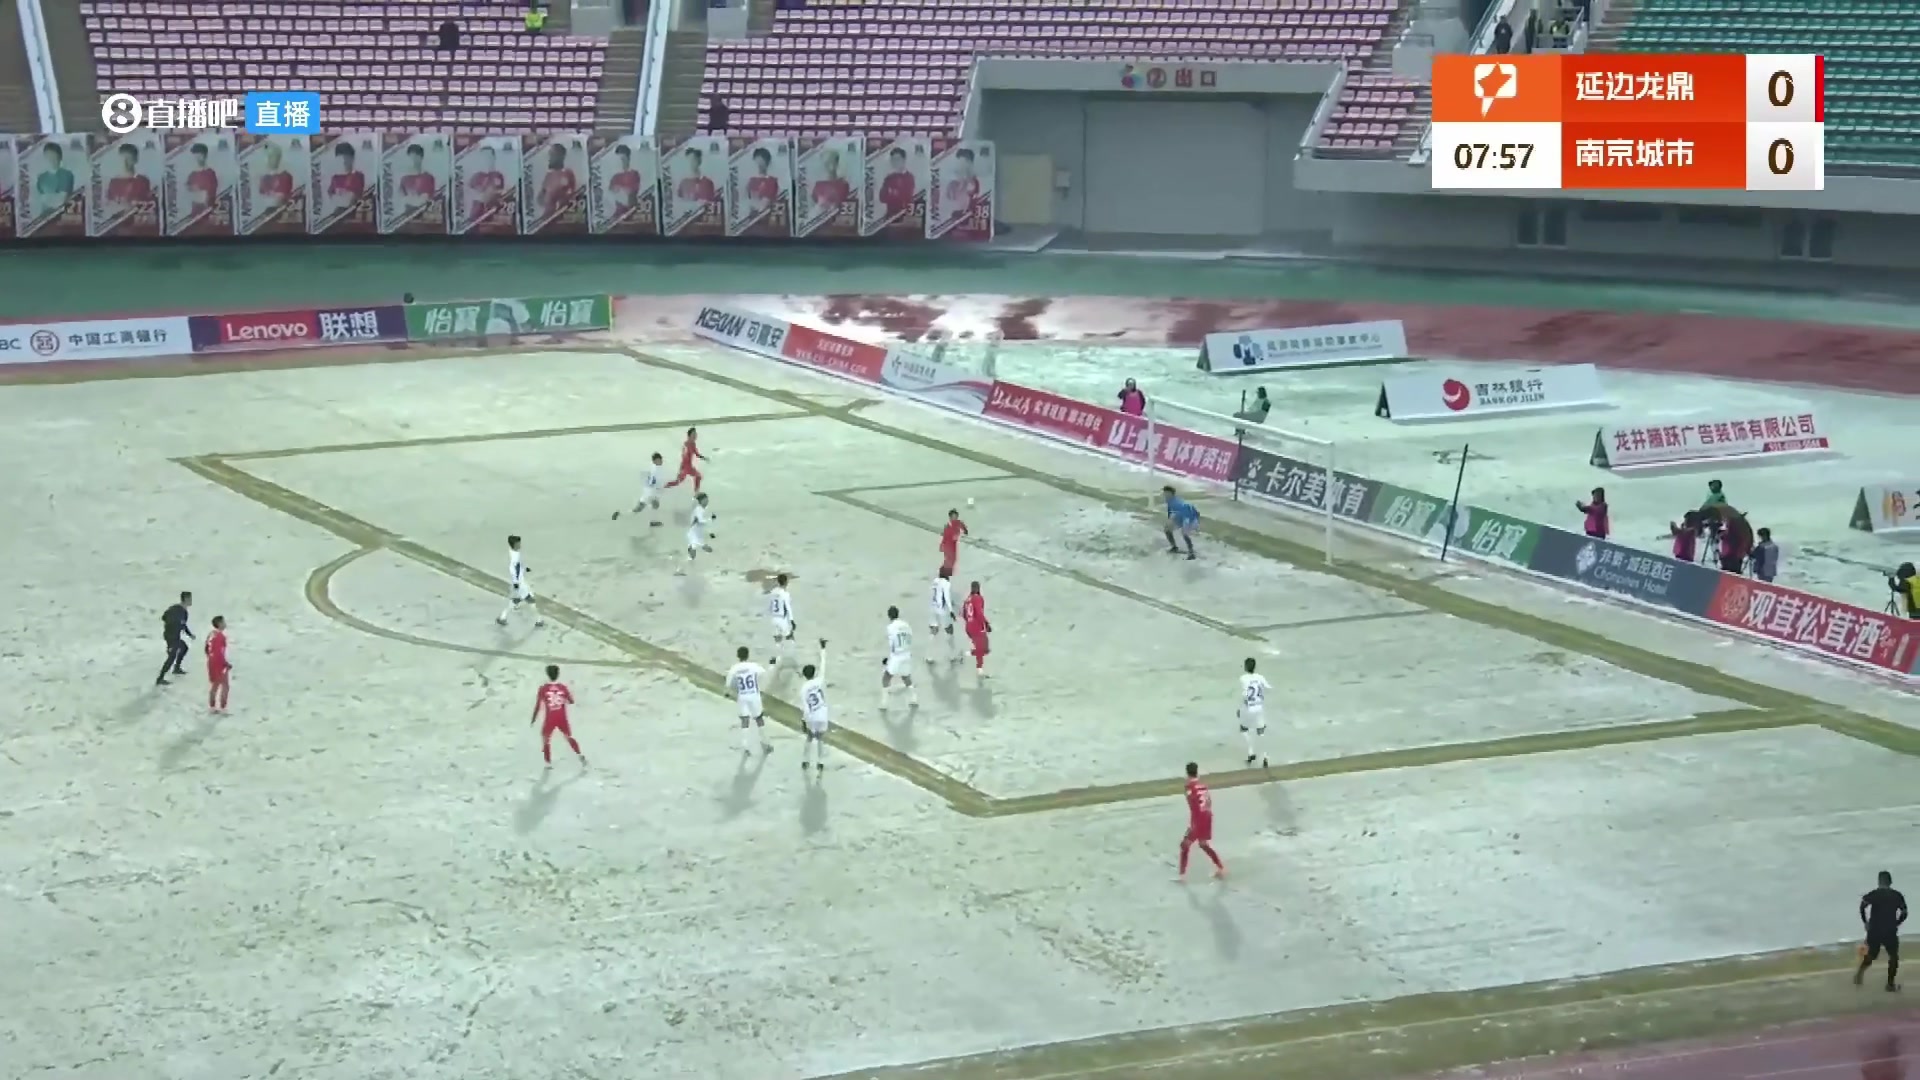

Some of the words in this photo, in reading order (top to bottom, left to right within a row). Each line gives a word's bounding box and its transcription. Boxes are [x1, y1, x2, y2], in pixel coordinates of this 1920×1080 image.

[226, 322, 308, 341] Lenovo
[319, 310, 379, 340] 联想
[69, 329, 167, 346] 中国工商银行
[1475, 378, 1543, 396] 吉林银行
[1479, 395, 1504, 406] BANK
[1506, 395, 1518, 404] OF
[1520, 393, 1545, 403] JILIN
[1265, 462, 1368, 516] 卡尔美体育
[1742, 589, 1885, 659] 观茸松茸酒
[737, 674, 754, 691] 36
[808, 688, 825, 707] 31
[1248, 685, 1264, 701] 24
